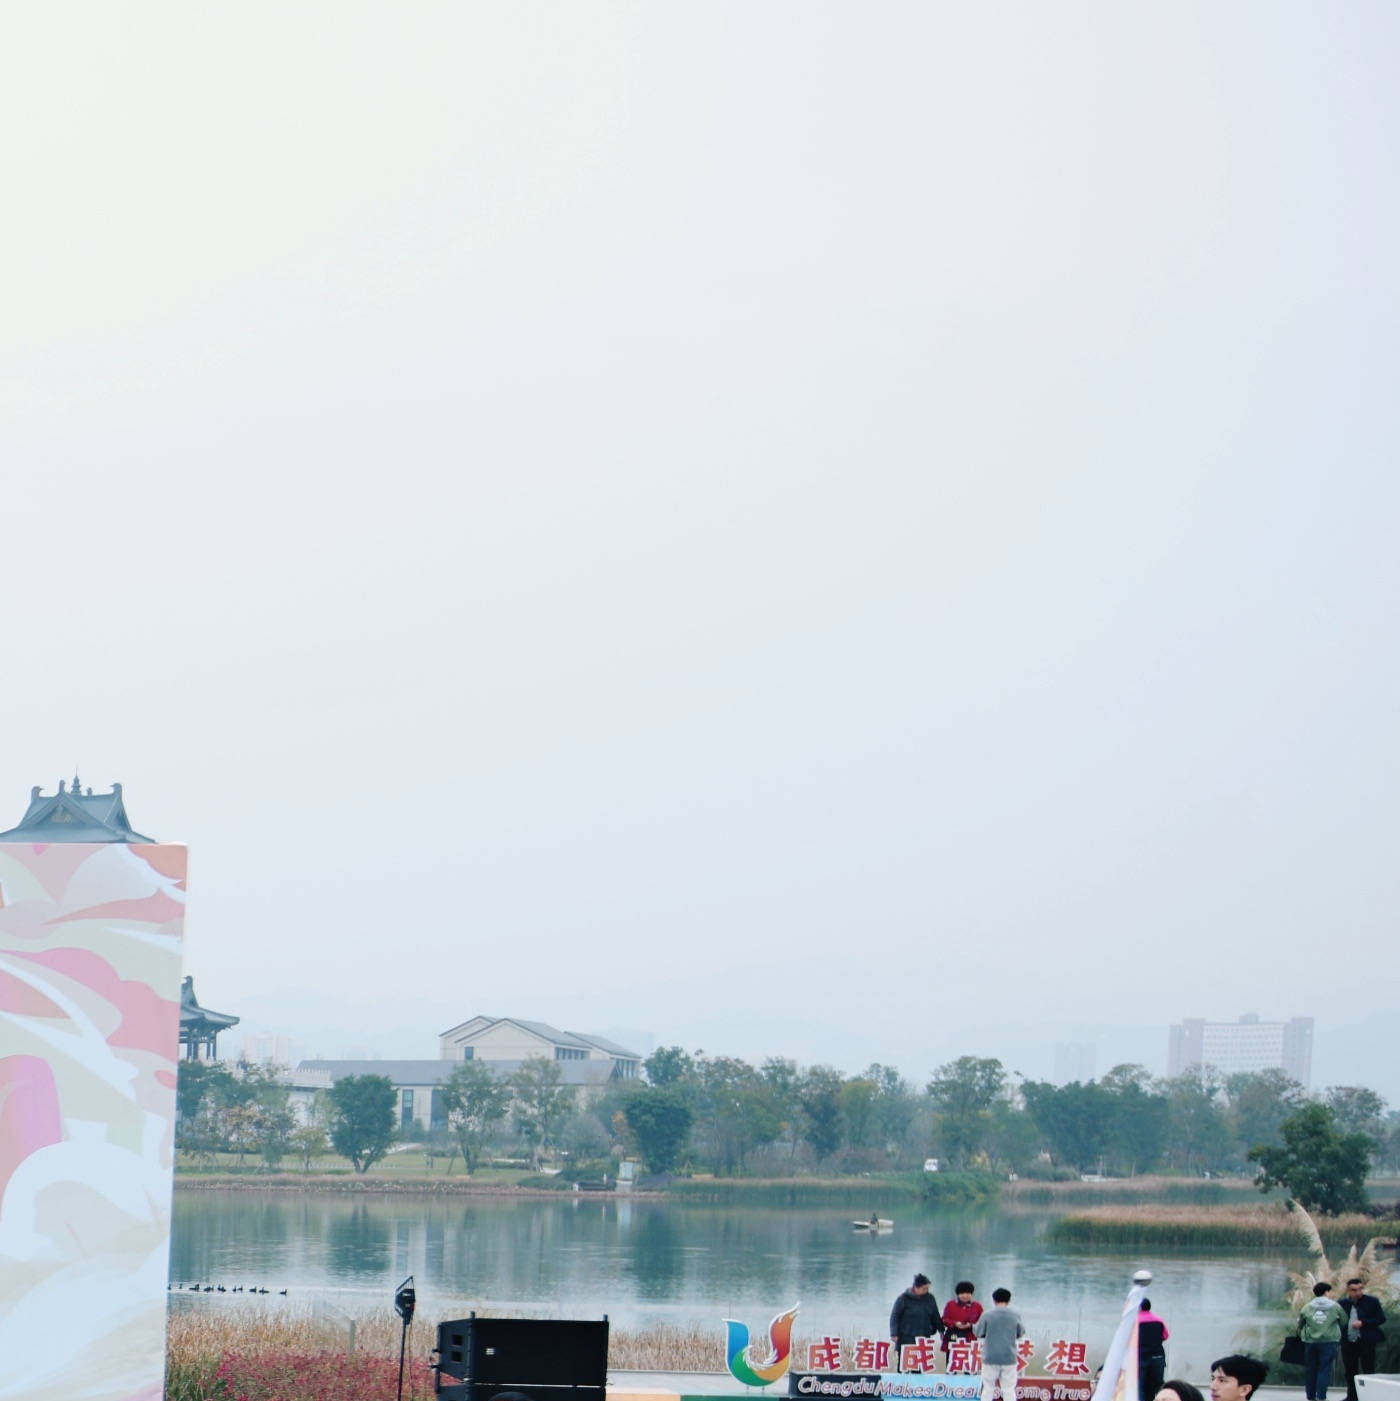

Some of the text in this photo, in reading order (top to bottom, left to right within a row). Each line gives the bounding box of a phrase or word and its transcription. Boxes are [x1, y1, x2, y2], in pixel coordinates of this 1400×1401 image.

[798, 1376, 875, 1397] Chengdu
[874, 1381, 934, 1398] Makes
[1052, 1384, 1091, 1401] True
